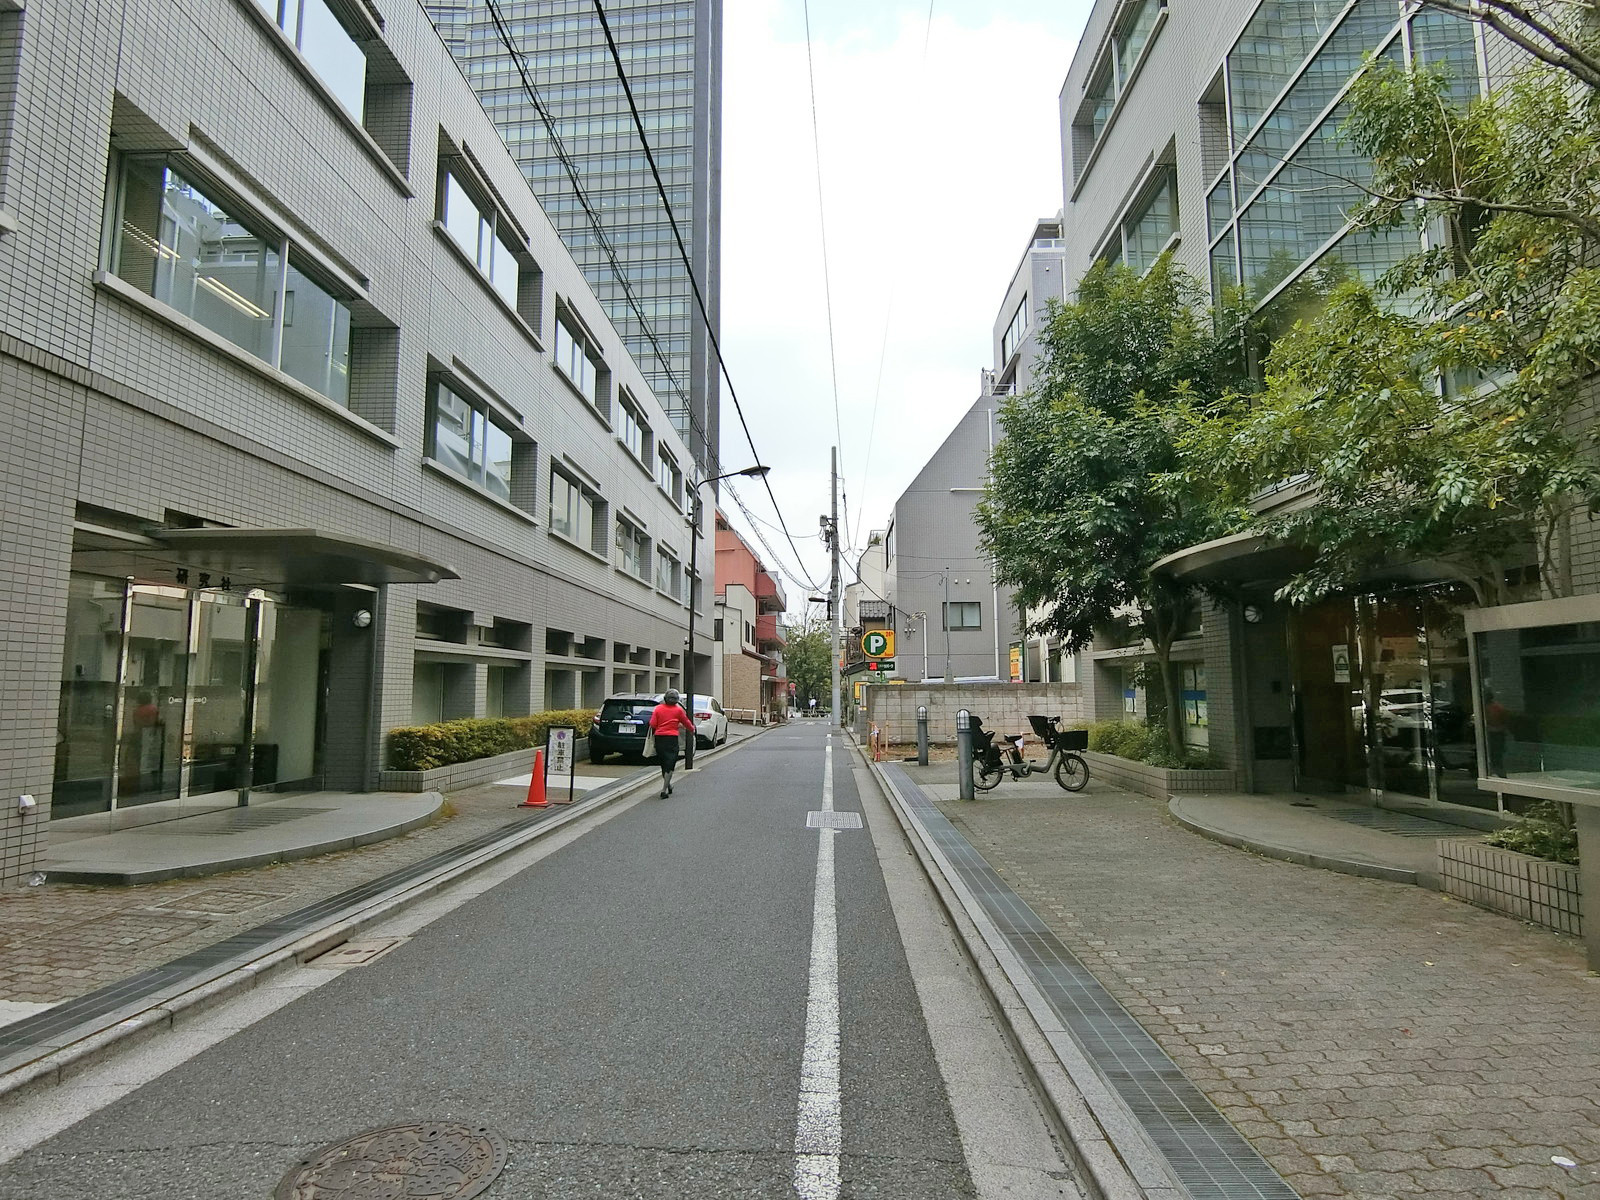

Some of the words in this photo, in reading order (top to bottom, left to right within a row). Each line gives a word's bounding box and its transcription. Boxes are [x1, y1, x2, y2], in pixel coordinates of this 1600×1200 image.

[176, 567, 232, 591] 研究社
[870, 635, 884, 653] P
[555, 741, 566, 772] 駐車禁止
